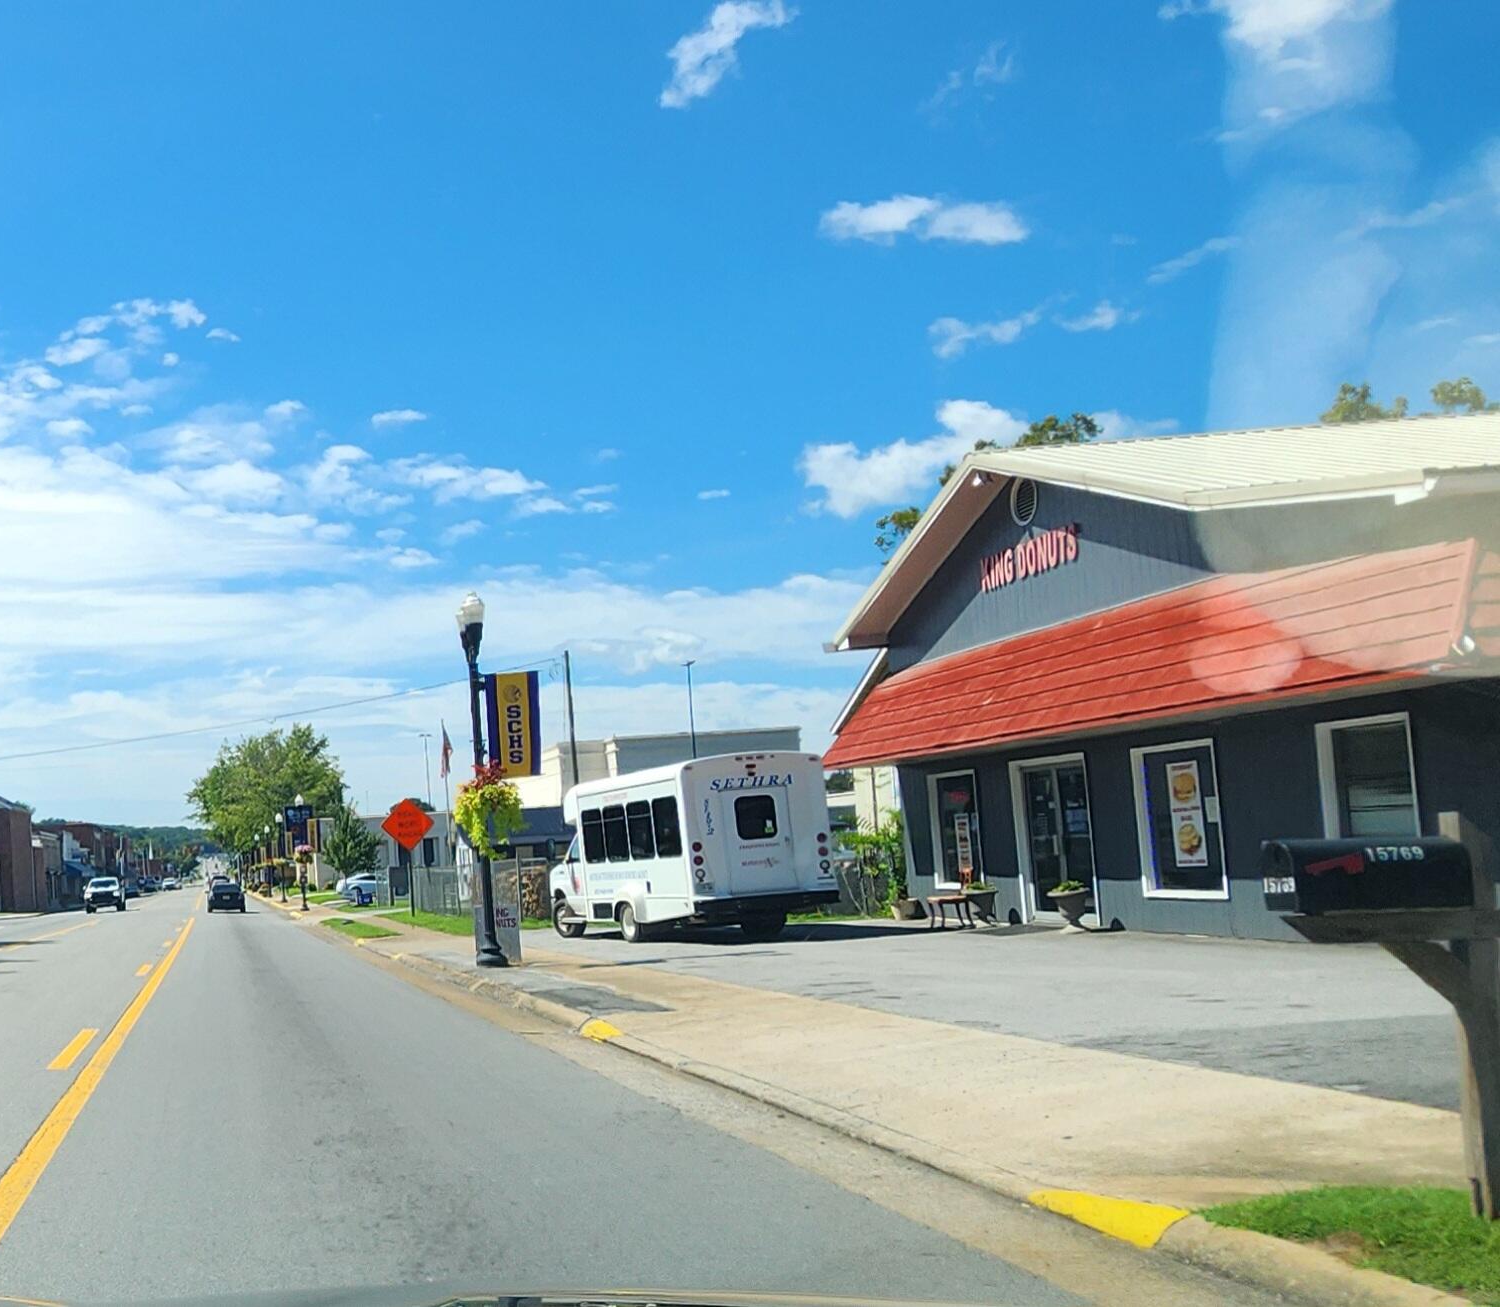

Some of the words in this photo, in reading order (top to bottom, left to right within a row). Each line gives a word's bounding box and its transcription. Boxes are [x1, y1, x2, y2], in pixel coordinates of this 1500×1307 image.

[981, 548, 1014, 592] KING
[1016, 525, 1077, 579] DONUTS
[506, 704, 524, 765] SCHS
[710, 774, 793, 791] SETHRA
[1365, 846, 1425, 862] 15769
[496, 918, 517, 928] NUTS
